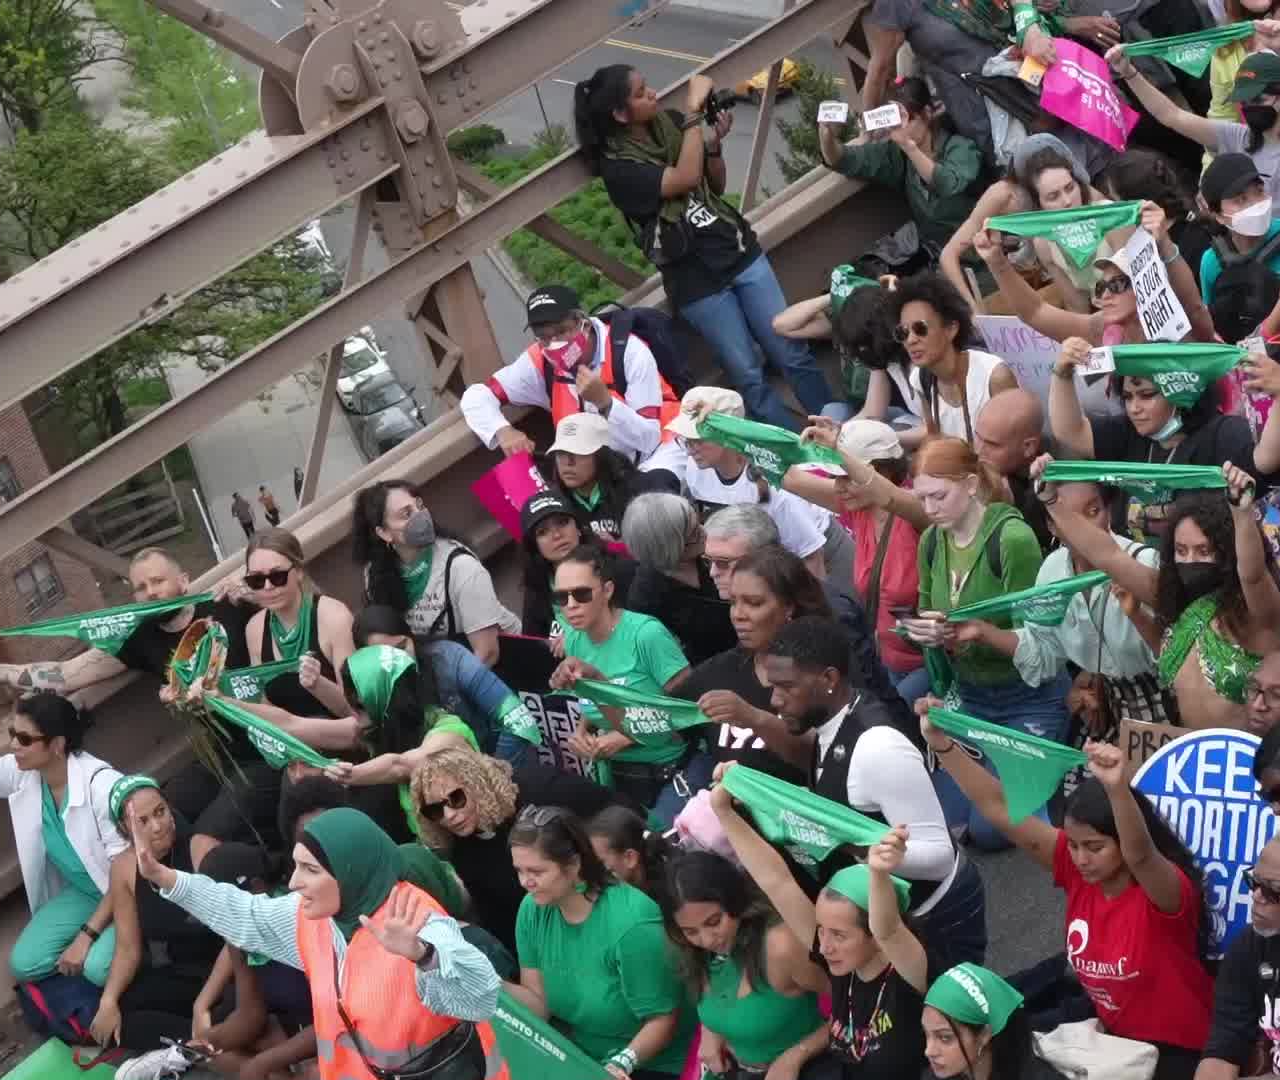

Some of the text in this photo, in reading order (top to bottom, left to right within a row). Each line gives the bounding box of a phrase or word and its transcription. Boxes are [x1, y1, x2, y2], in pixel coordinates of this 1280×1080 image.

[1143, 262, 1162, 296] OUR
[1142, 292, 1176, 339] RIGHT
[1153, 371, 1200, 387] ABORTO
[628, 720, 671, 735] LIBRE
[1165, 739, 1262, 801] KEE
